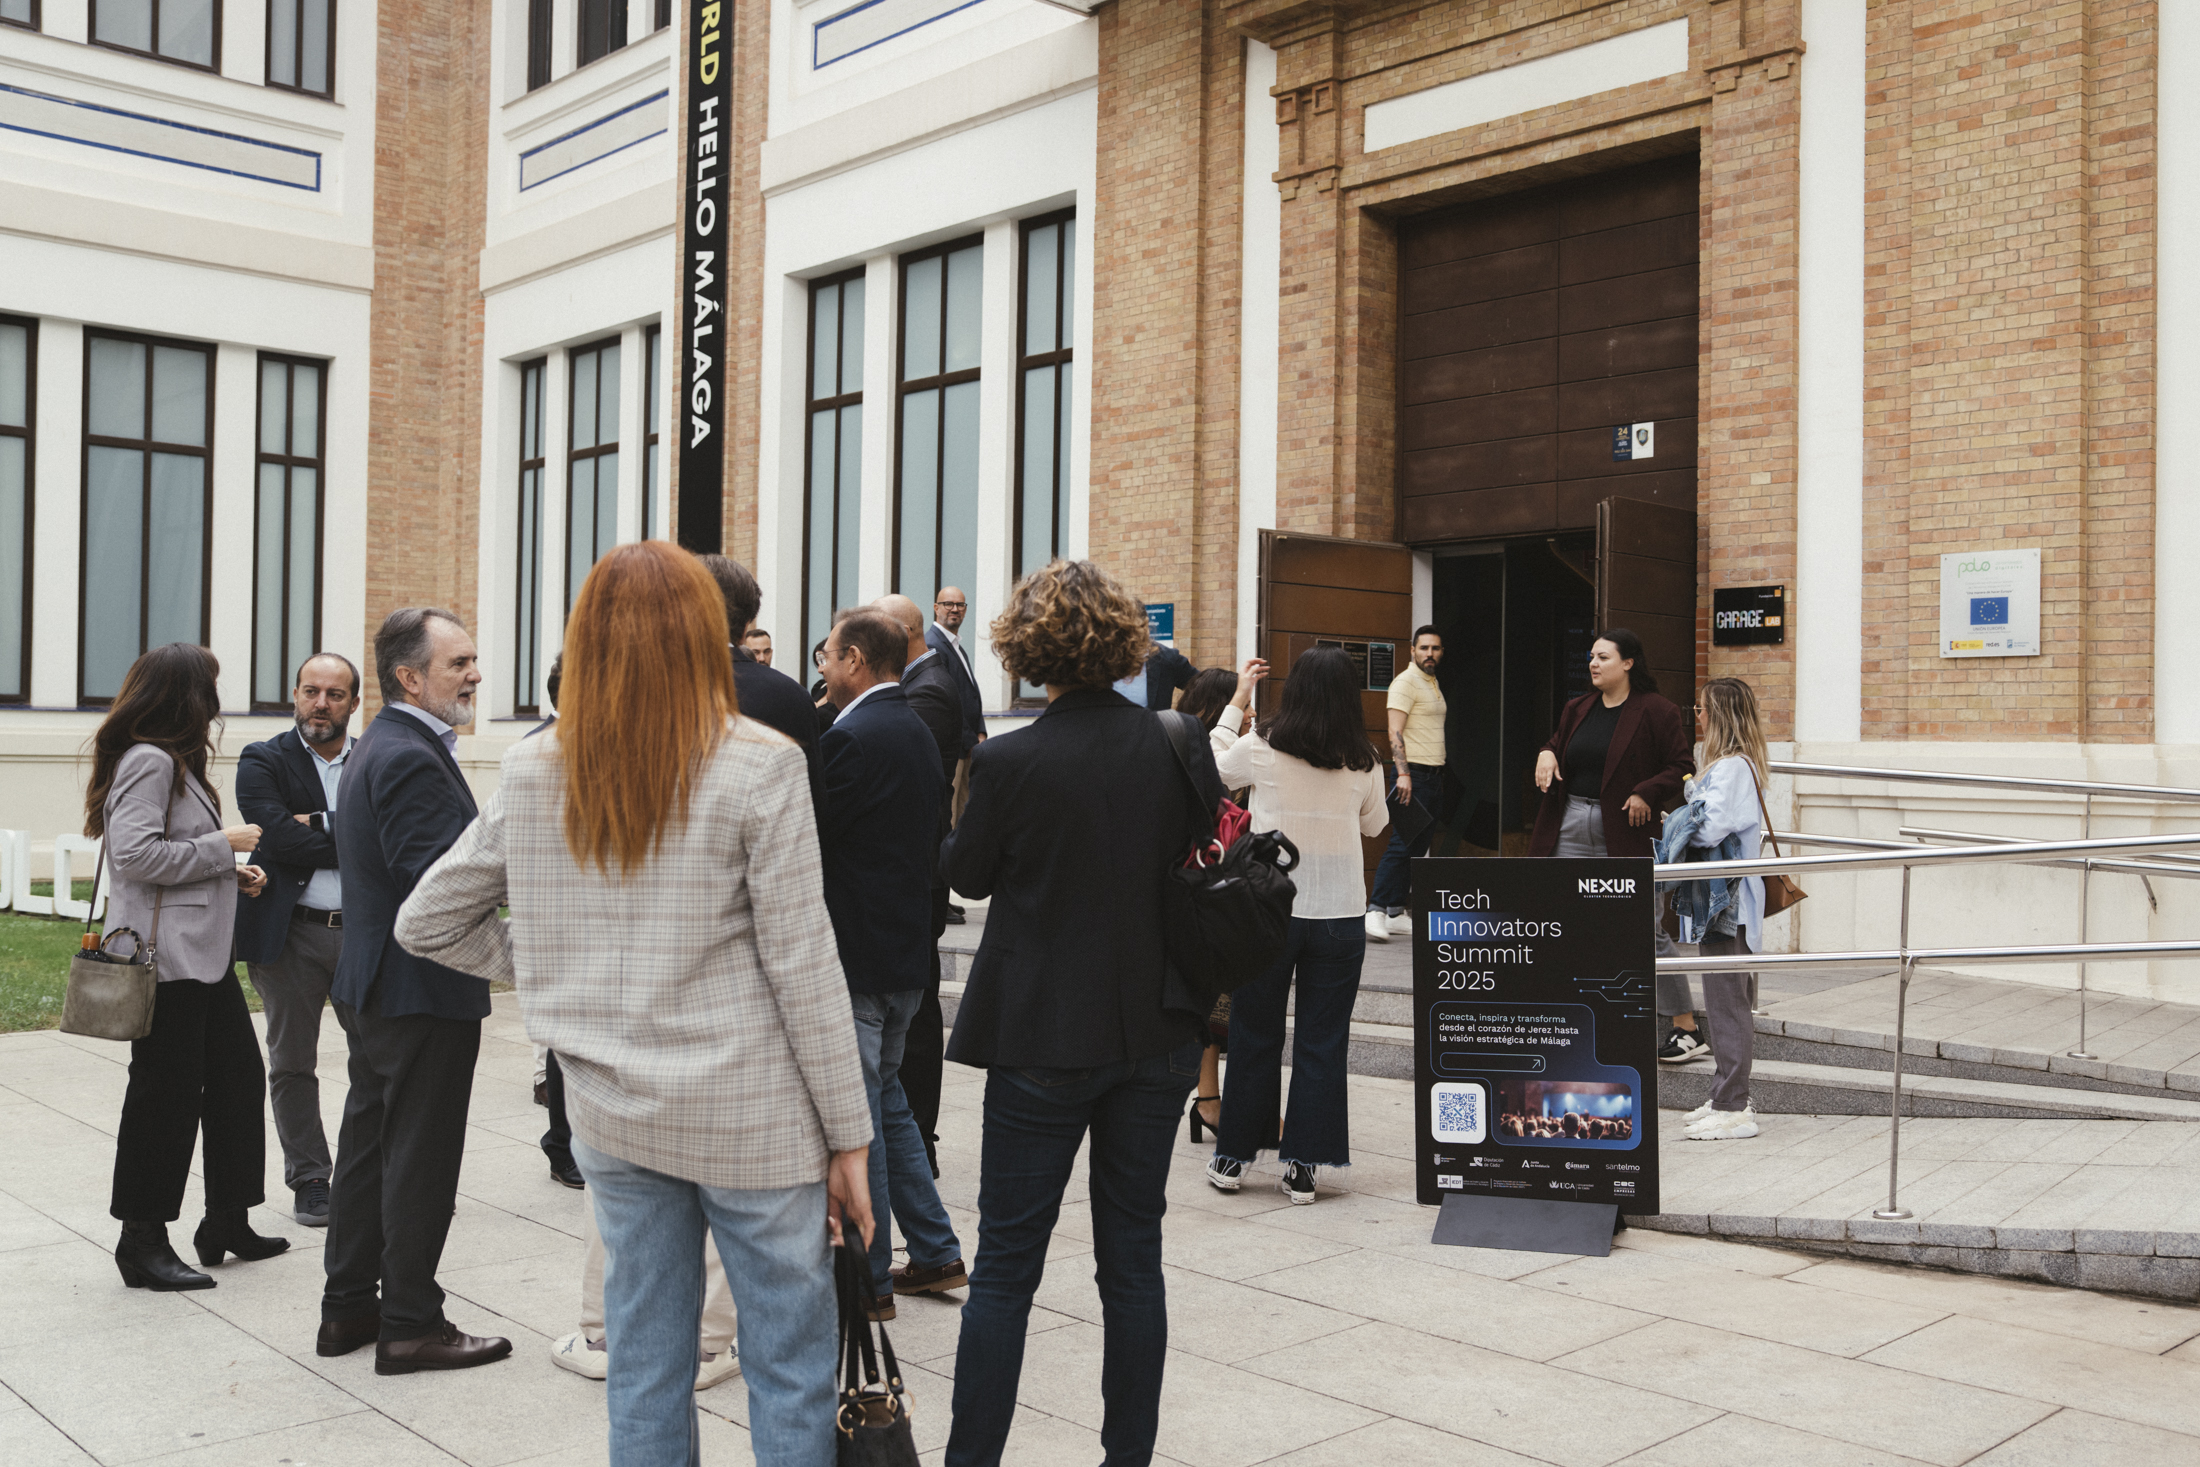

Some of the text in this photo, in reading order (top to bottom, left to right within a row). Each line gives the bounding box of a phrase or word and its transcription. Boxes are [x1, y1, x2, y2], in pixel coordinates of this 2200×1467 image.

[692, 0, 720, 449] RLD HELLO MÁLAGA
[1716, 610, 1780, 629] GARAGE LAB
[1578, 878, 1636, 894] NEXUR
[1436, 889, 1490, 909] Tech
[1437, 917, 1562, 937] Innovators
[1437, 943, 1533, 964] Summit
[1438, 970, 1495, 990] 2025
[1439, 1013, 1476, 1022] Conecta,
[1479, 1014, 1508, 1023] inspira
[1518, 1015, 1566, 1023] transforma
[1439, 1023, 1464, 1032] desde
[1450, 1034, 1473, 1042] visión
[1477, 1035, 1524, 1045] estratégica
[1541, 1037, 1571, 1046] Málaga
